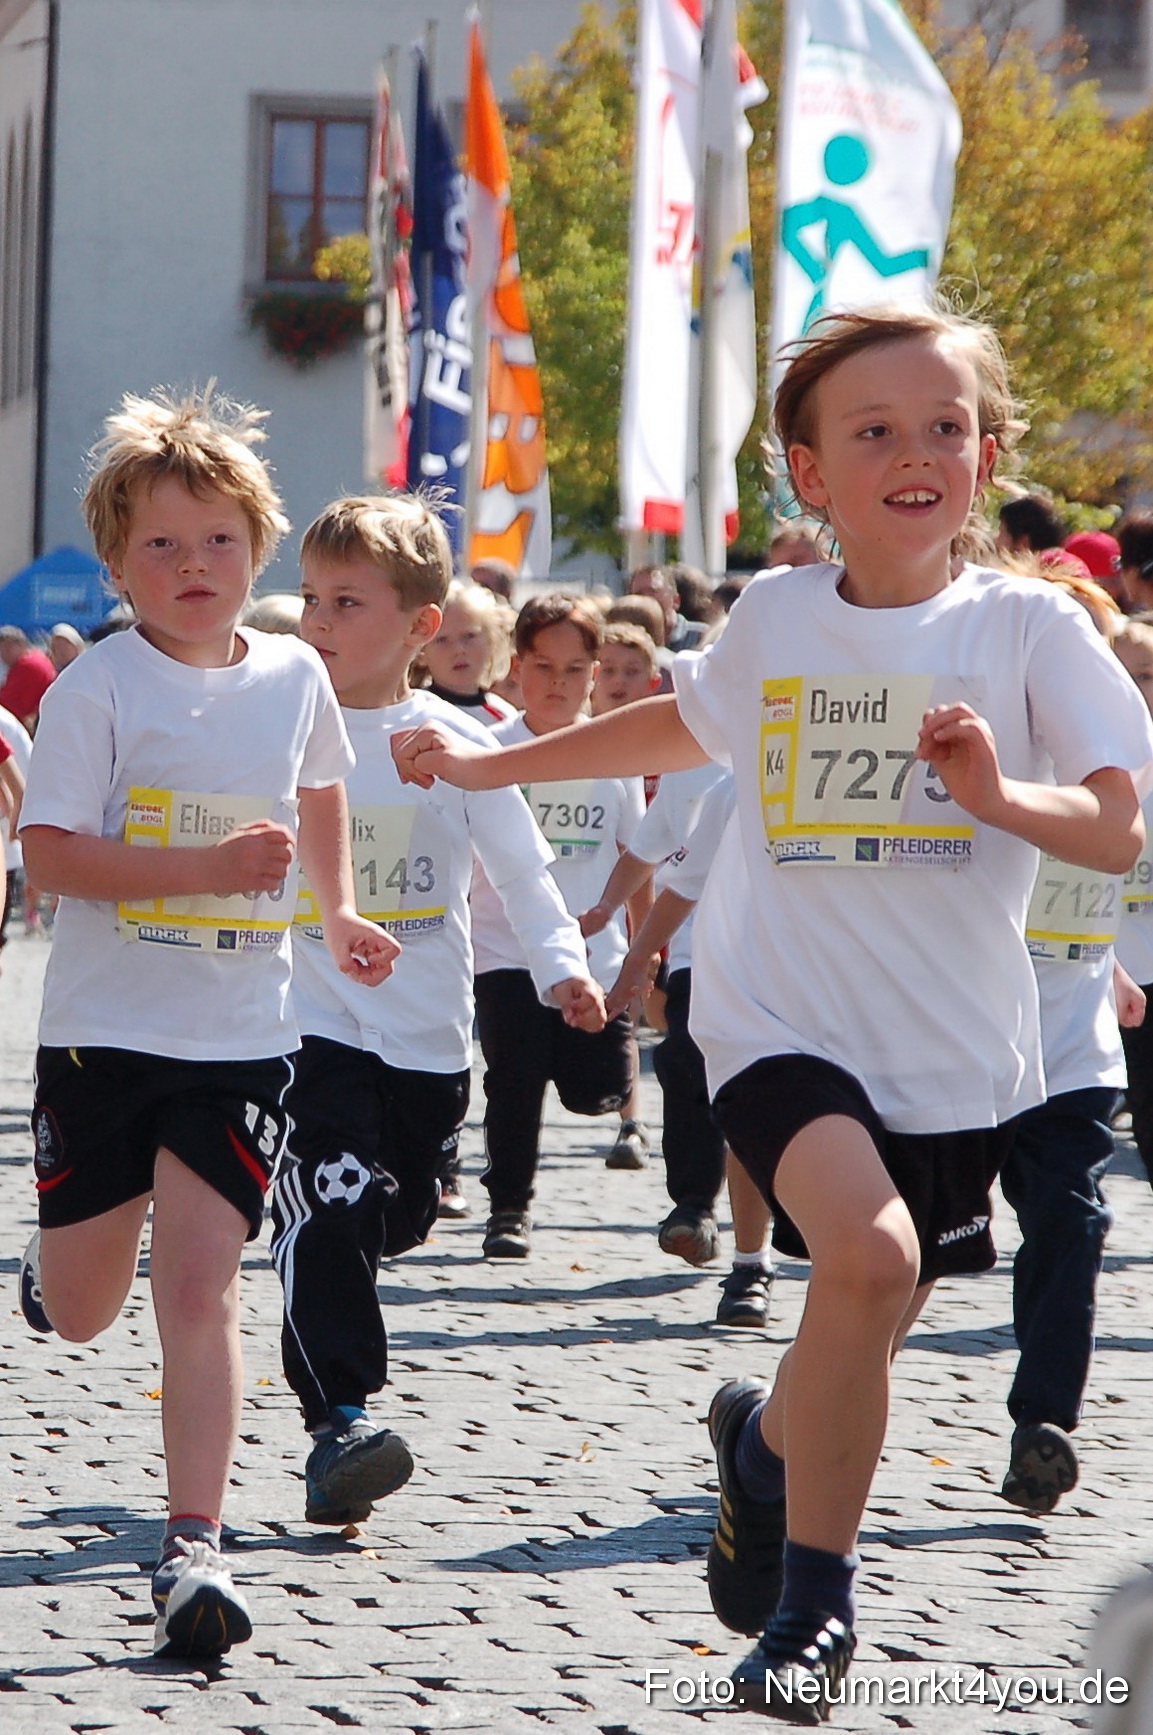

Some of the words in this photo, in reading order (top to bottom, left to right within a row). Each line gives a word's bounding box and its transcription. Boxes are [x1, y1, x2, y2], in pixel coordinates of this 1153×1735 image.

[810, 688, 888, 724] David
[766, 749, 784, 776] K4
[180, 804, 235, 836] Elias
[538, 803, 606, 829] 7302
[883, 838, 972, 856] PFLEIDERER
[1045, 880, 1115, 917] 7122
[388, 915, 446, 932] PFLEIDERER
[244, 1101, 279, 1156] 13
[938, 1223, 978, 1246] JAKO
